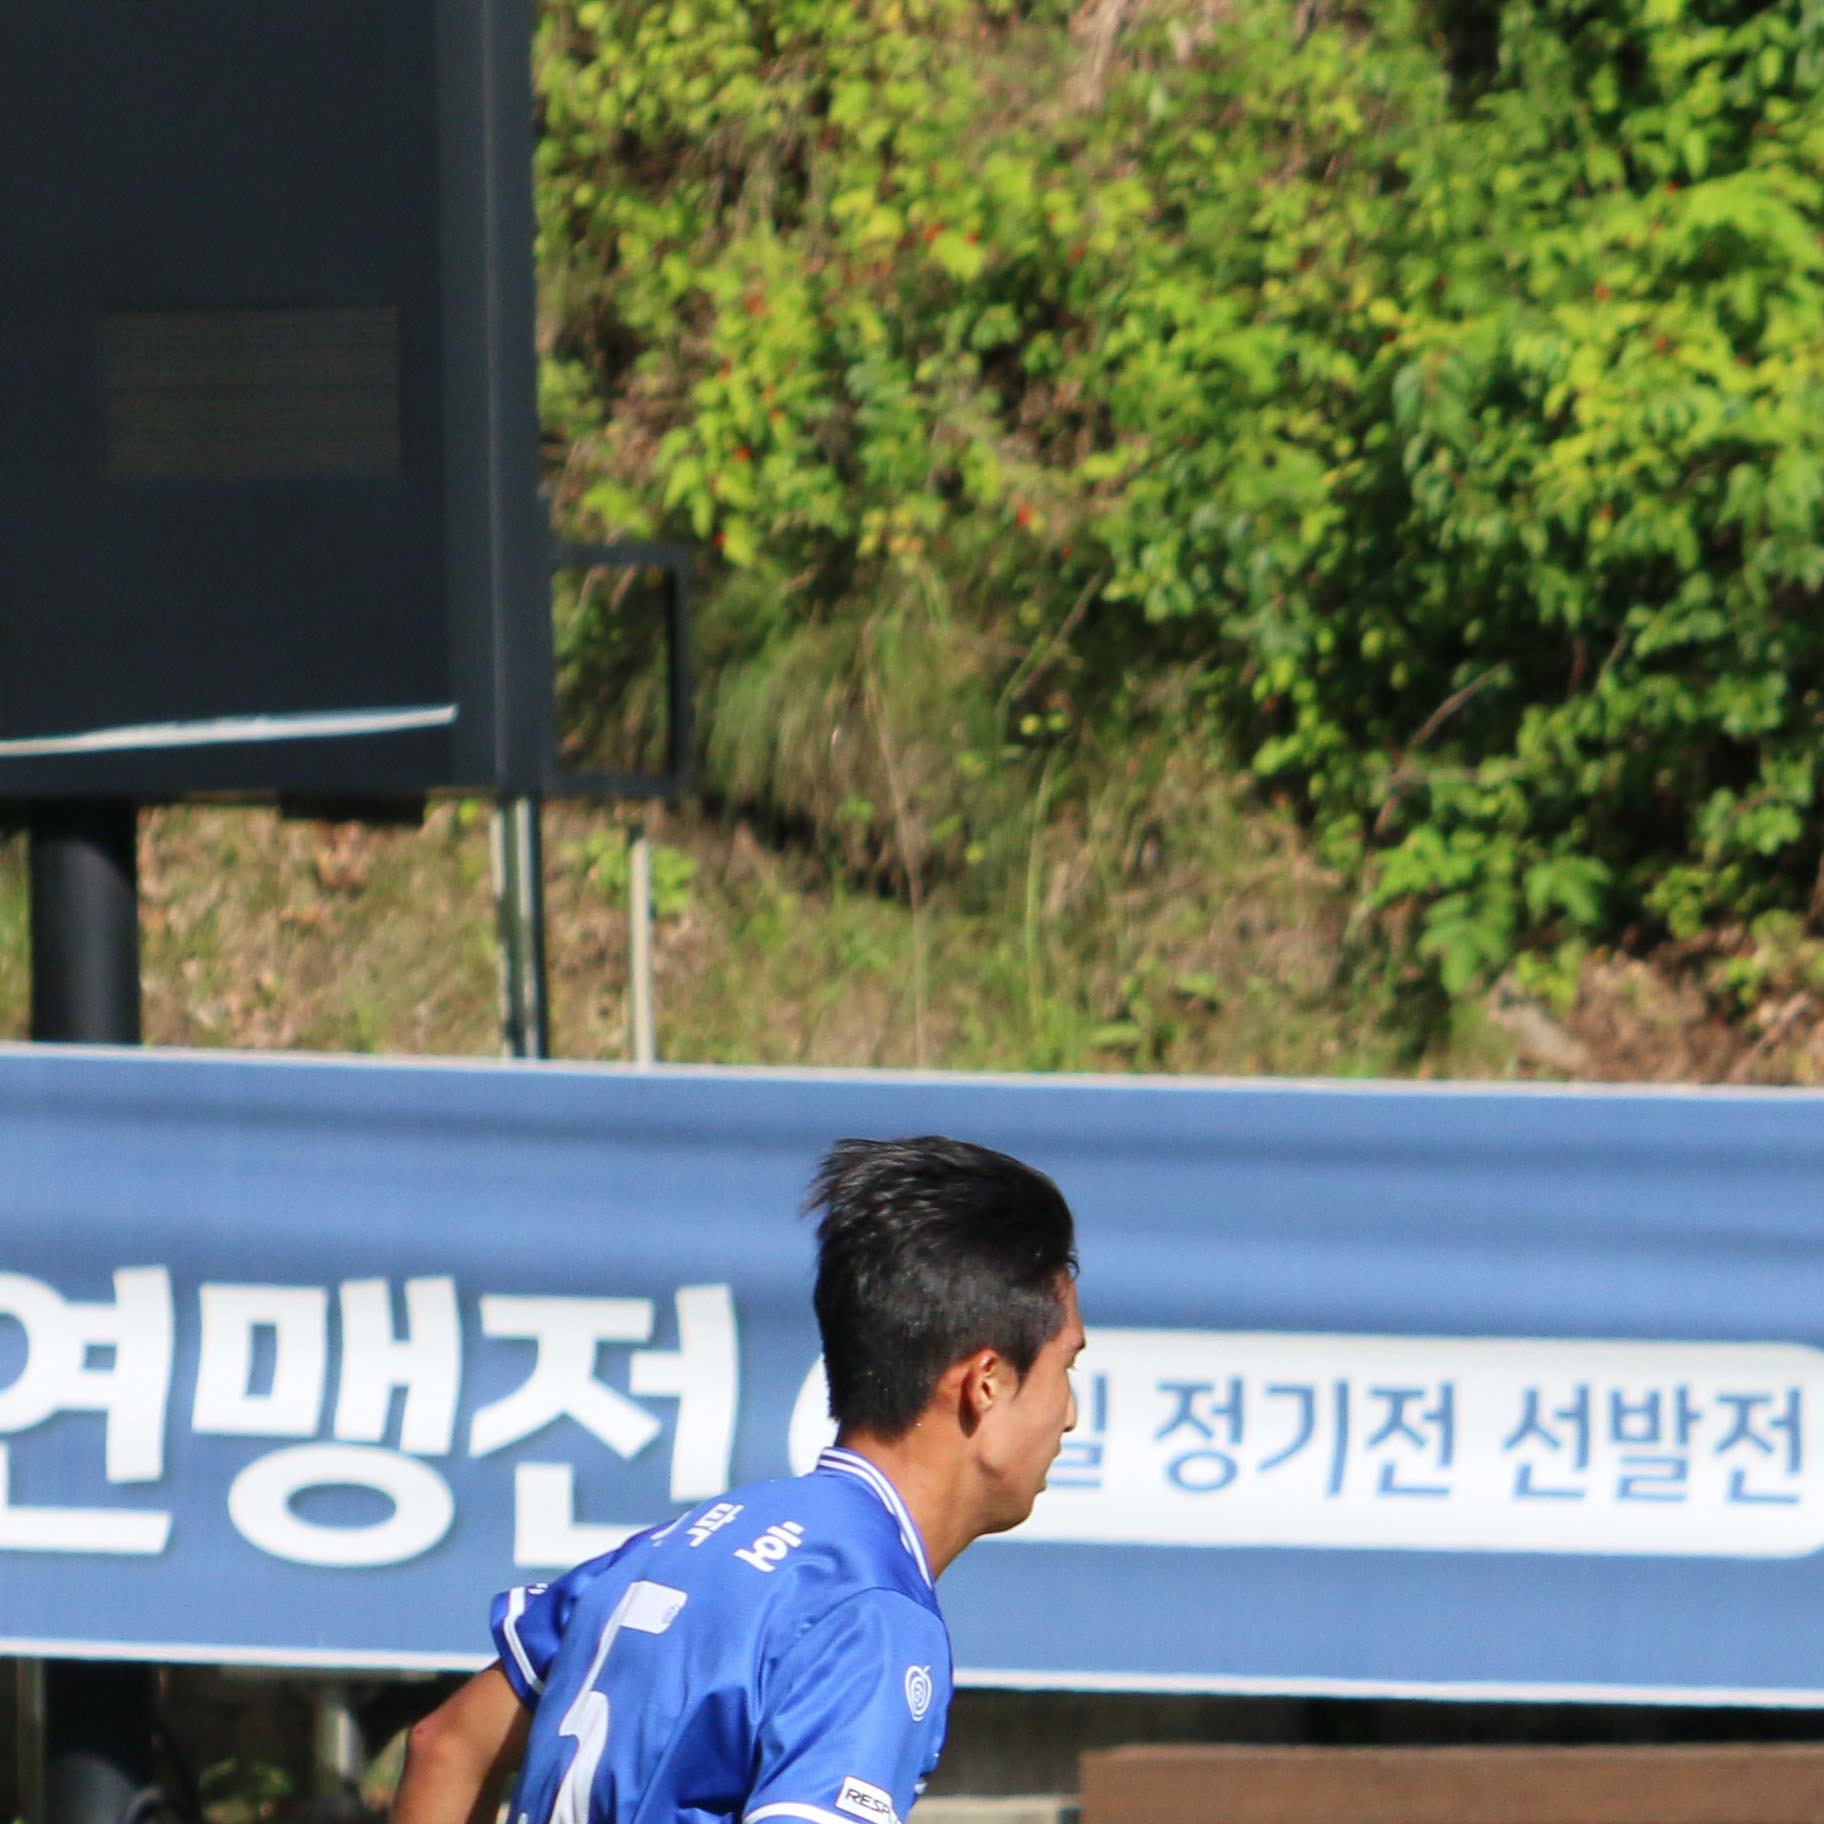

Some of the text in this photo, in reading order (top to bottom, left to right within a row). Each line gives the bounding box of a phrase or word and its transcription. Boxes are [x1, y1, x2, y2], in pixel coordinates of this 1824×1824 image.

[1155, 1376, 1455, 1499] 정기전
[1502, 1387, 1804, 1506] 선발전
[845, 1787, 892, 1815] RESP
